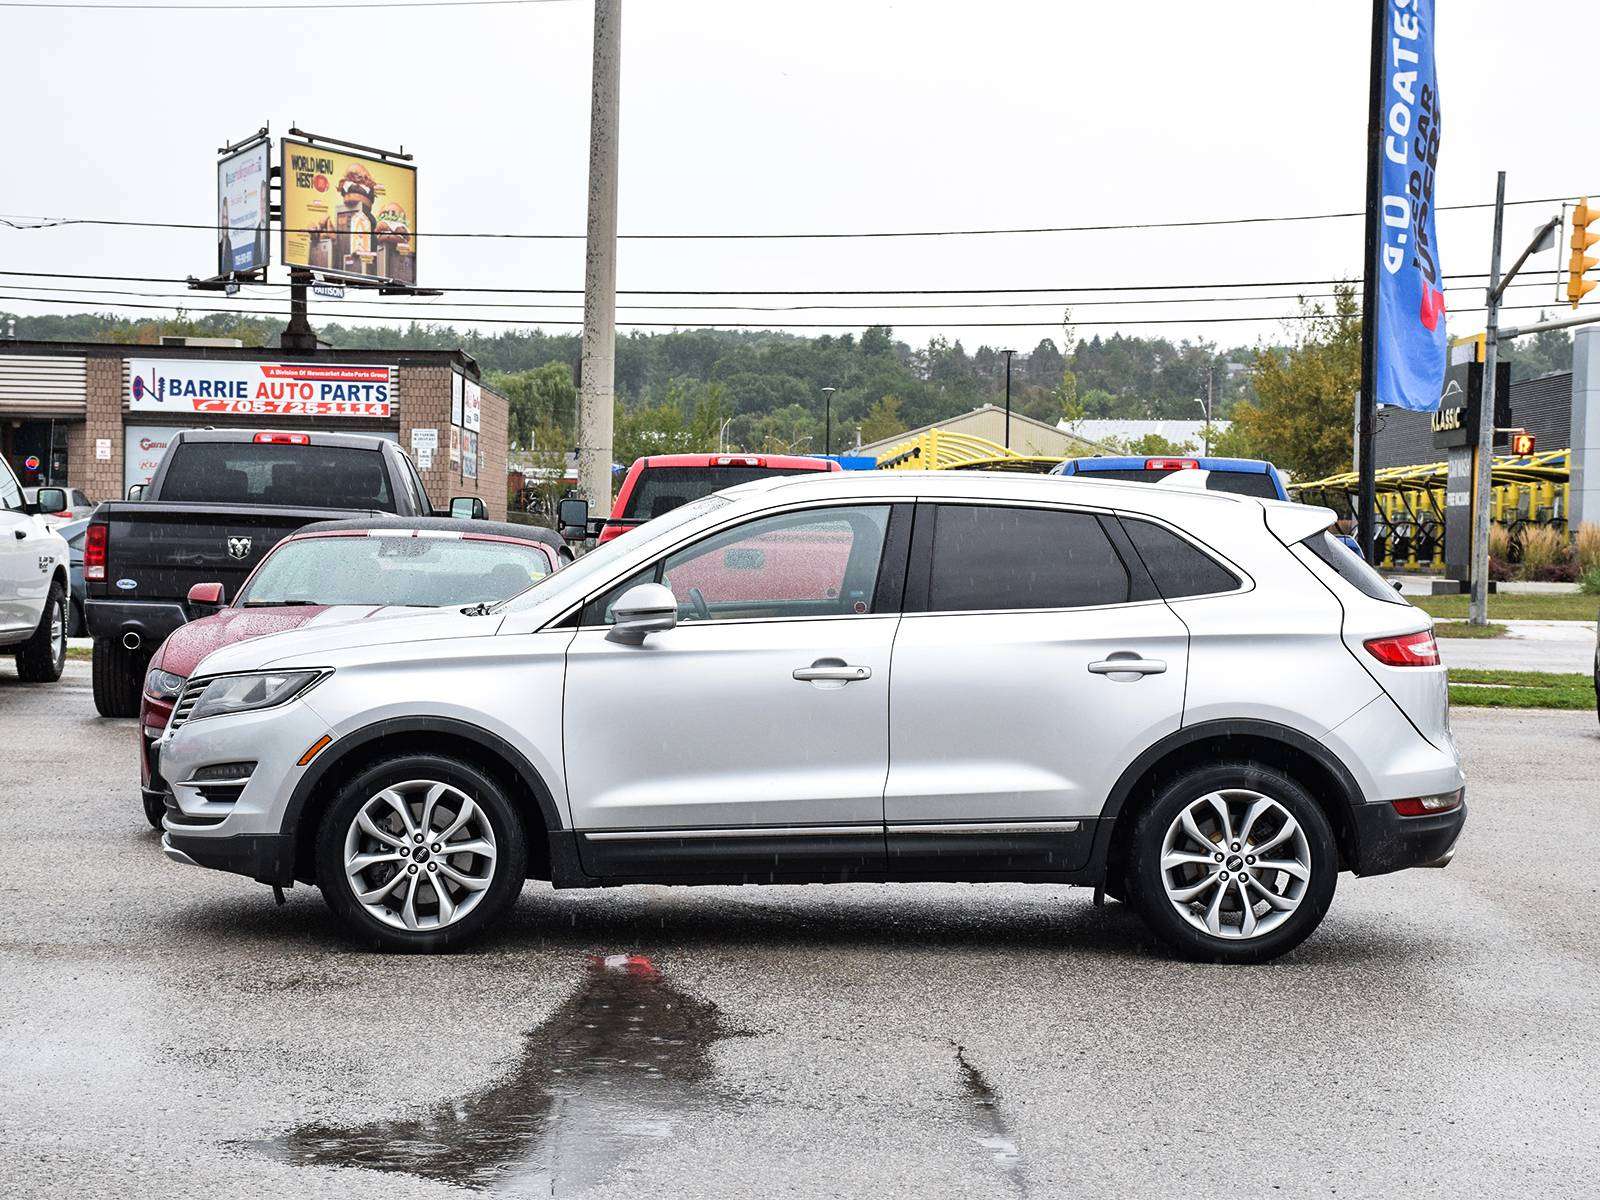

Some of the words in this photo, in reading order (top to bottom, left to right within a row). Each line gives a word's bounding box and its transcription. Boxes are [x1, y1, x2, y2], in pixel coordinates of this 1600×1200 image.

[1414, 83, 1433, 163] CAR
[291, 154, 315, 172] WORLD
[315, 158, 334, 175] MENU
[169, 378, 248, 399] BARRIE
[255, 382, 314, 400] AUTO
[320, 383, 388, 402] PARTS
[223, 400, 383, 416] 705-725-1114
[1431, 406, 1460, 432] KLASSIC
